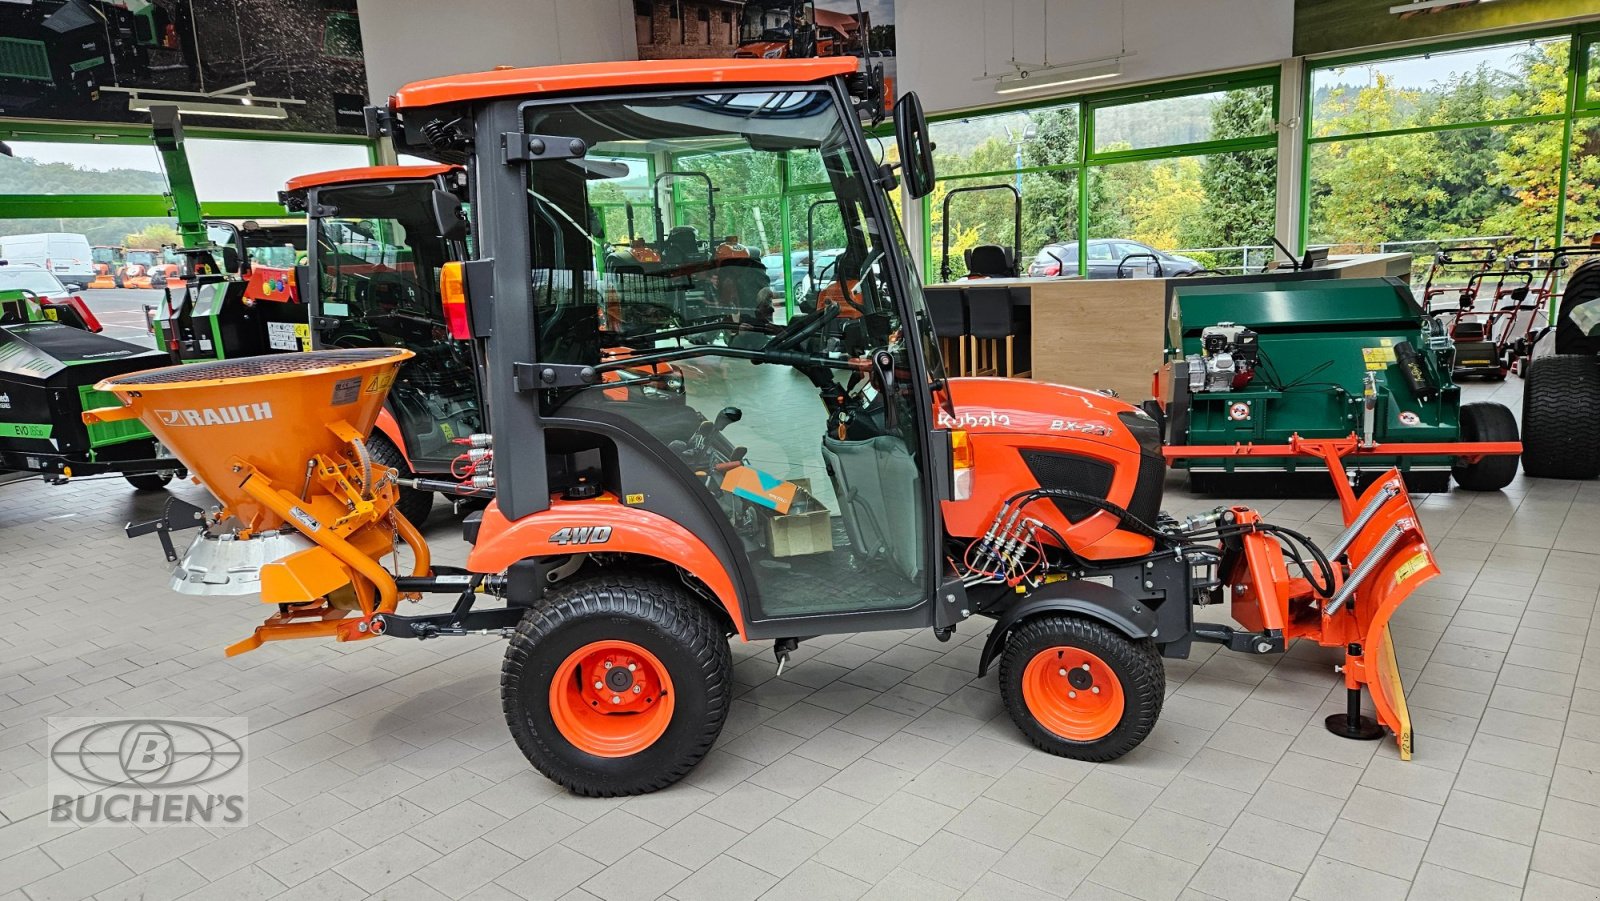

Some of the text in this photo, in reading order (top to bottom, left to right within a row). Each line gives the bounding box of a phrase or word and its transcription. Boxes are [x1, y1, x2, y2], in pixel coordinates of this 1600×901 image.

[181, 402, 273, 426] RAUCH
[937, 410, 1010, 428] Kubota
[14, 425, 29, 436] EVO
[548, 526, 613, 545] 4WD
